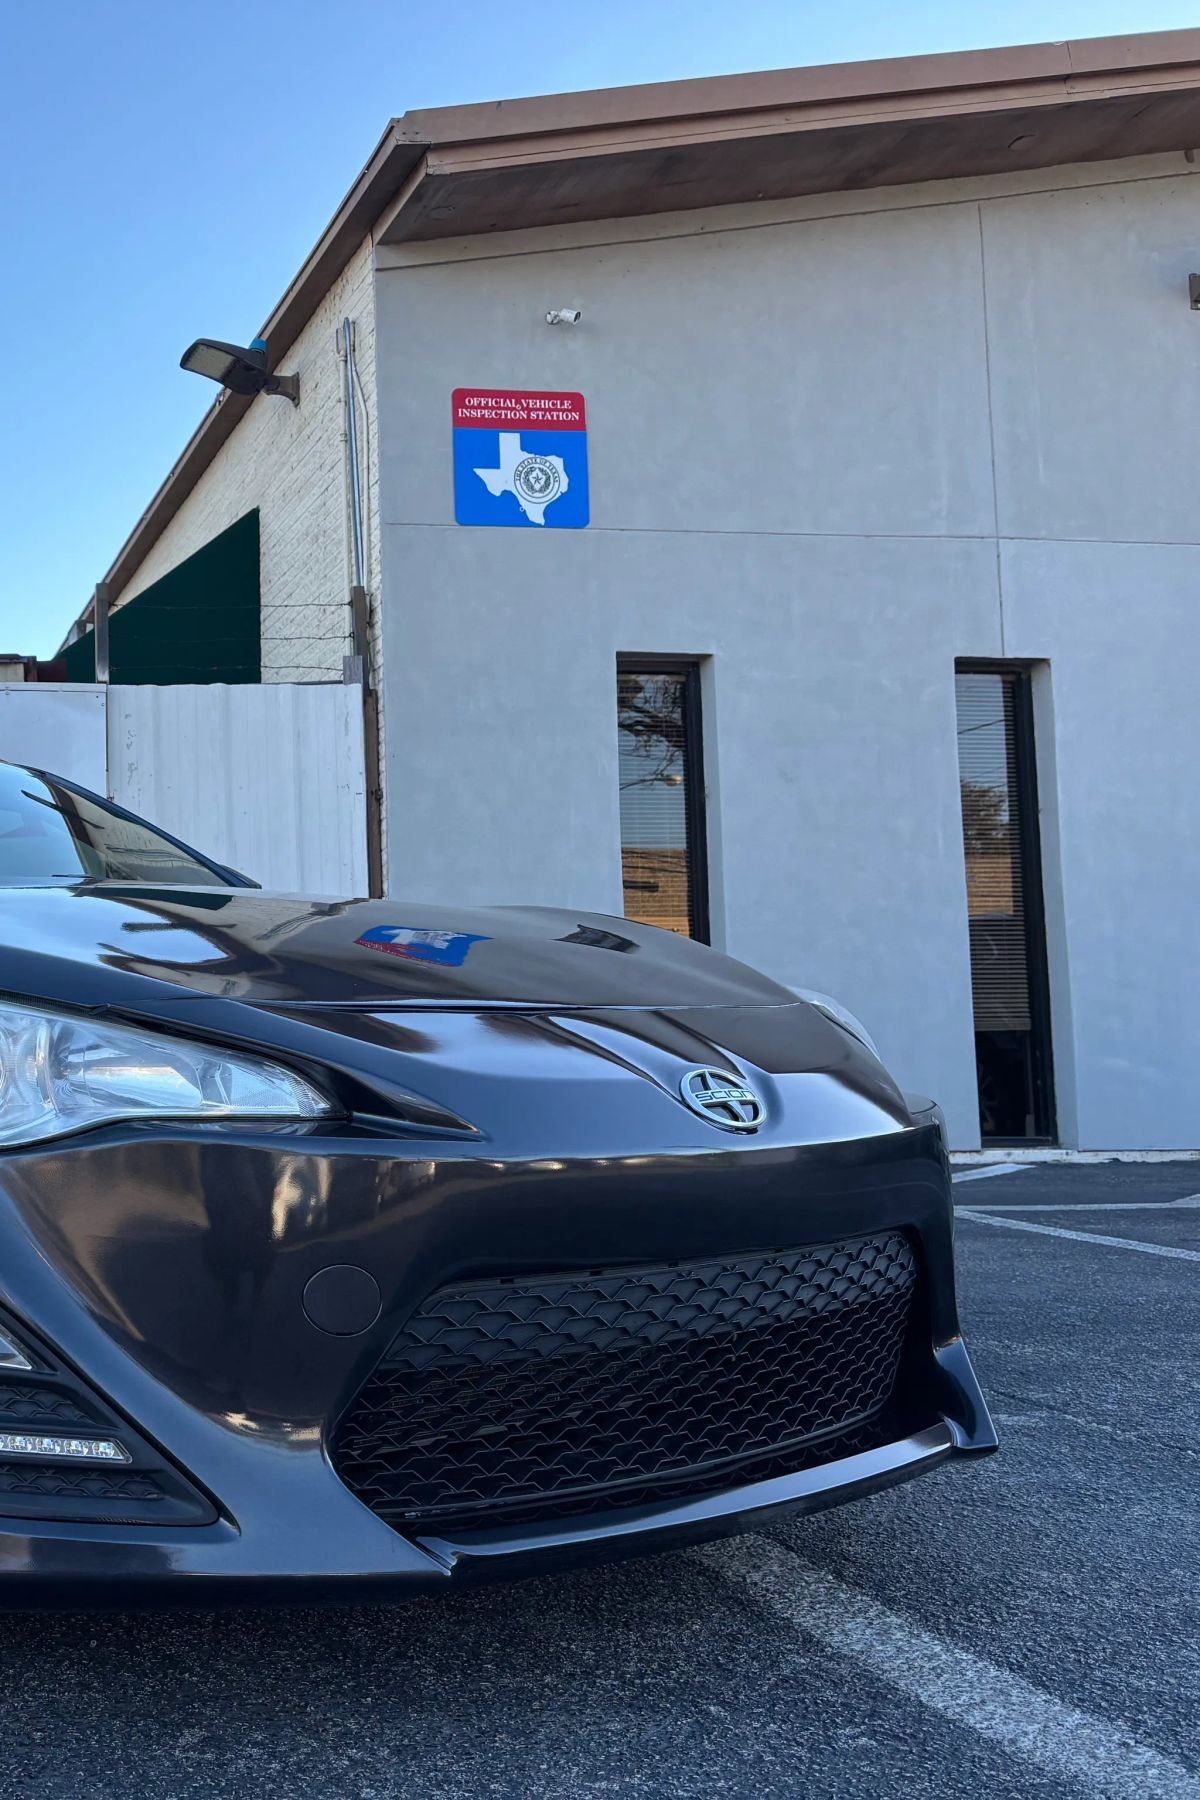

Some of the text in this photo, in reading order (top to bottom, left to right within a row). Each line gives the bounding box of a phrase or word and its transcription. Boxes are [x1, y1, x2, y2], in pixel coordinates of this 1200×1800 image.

[465, 397, 572, 410] OFFICIAL VEHICLE
[458, 408, 580, 421] INSPECTION STATION
[694, 1089, 756, 1103] SCION
